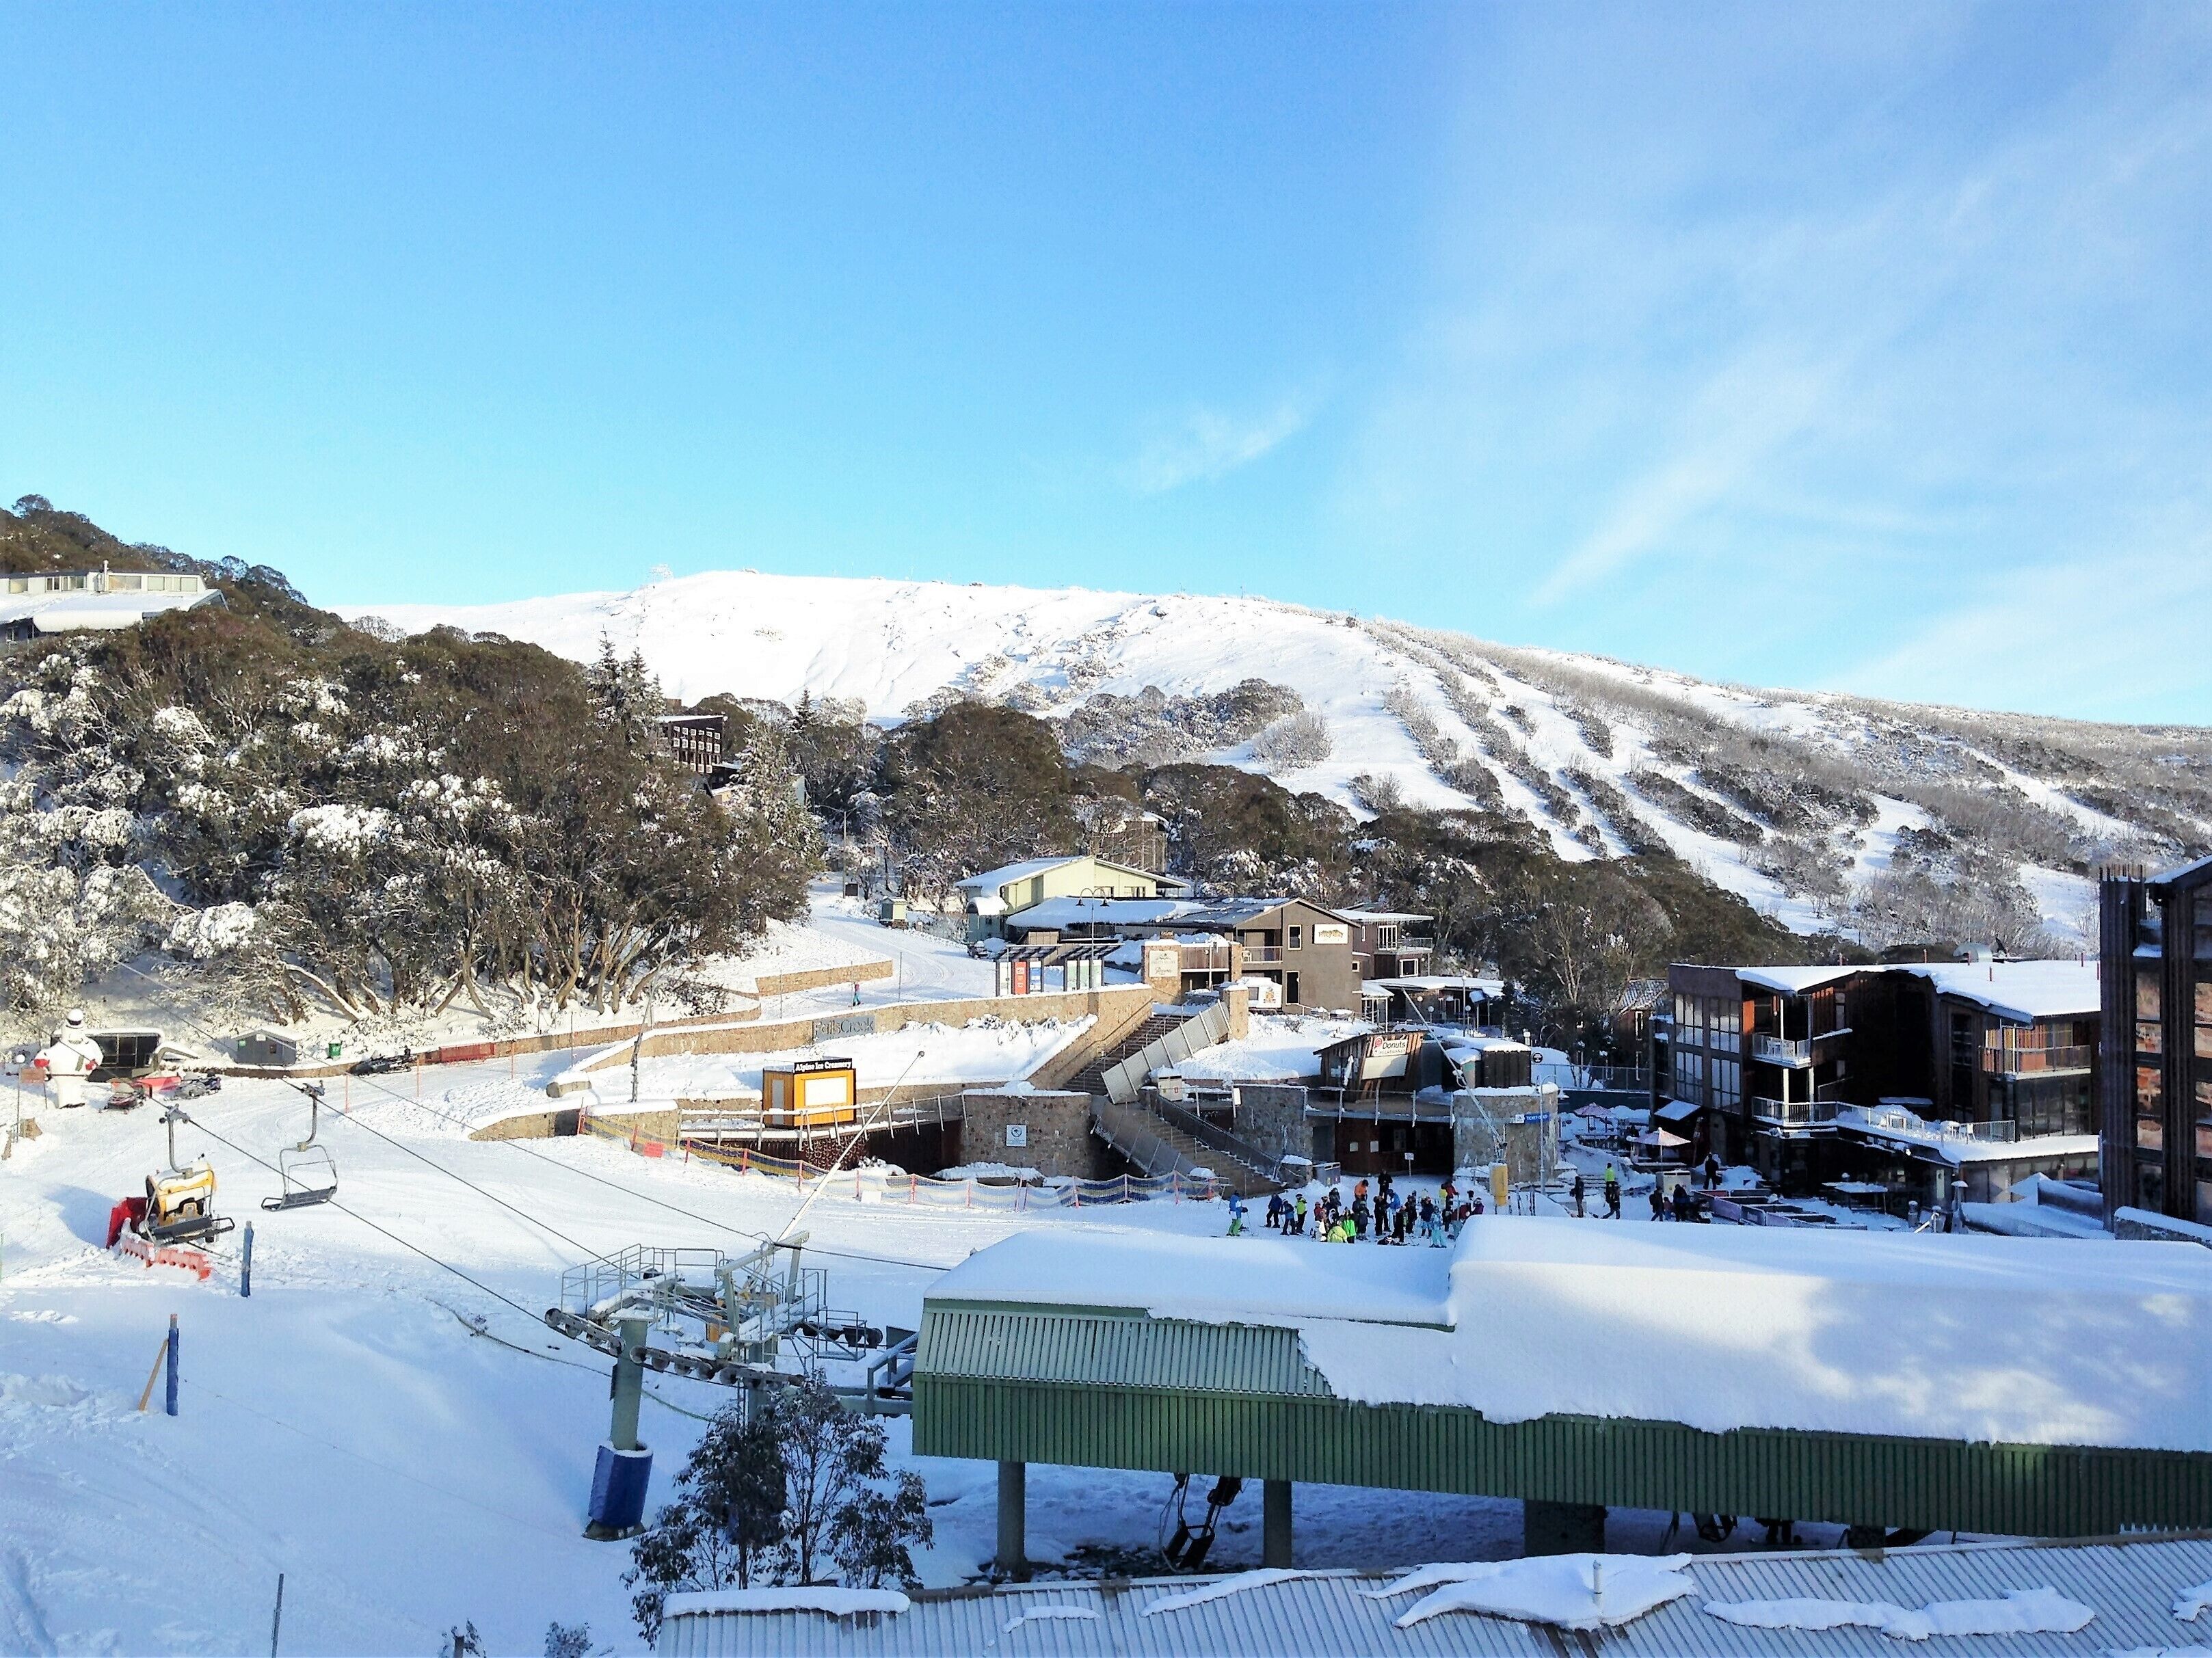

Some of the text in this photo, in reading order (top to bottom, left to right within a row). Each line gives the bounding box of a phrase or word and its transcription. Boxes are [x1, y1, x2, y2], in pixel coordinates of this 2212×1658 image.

[1383, 1041, 1406, 1049] Donuts
[795, 1063, 814, 1072] Alpine
[824, 1061, 852, 1069] Creamery
